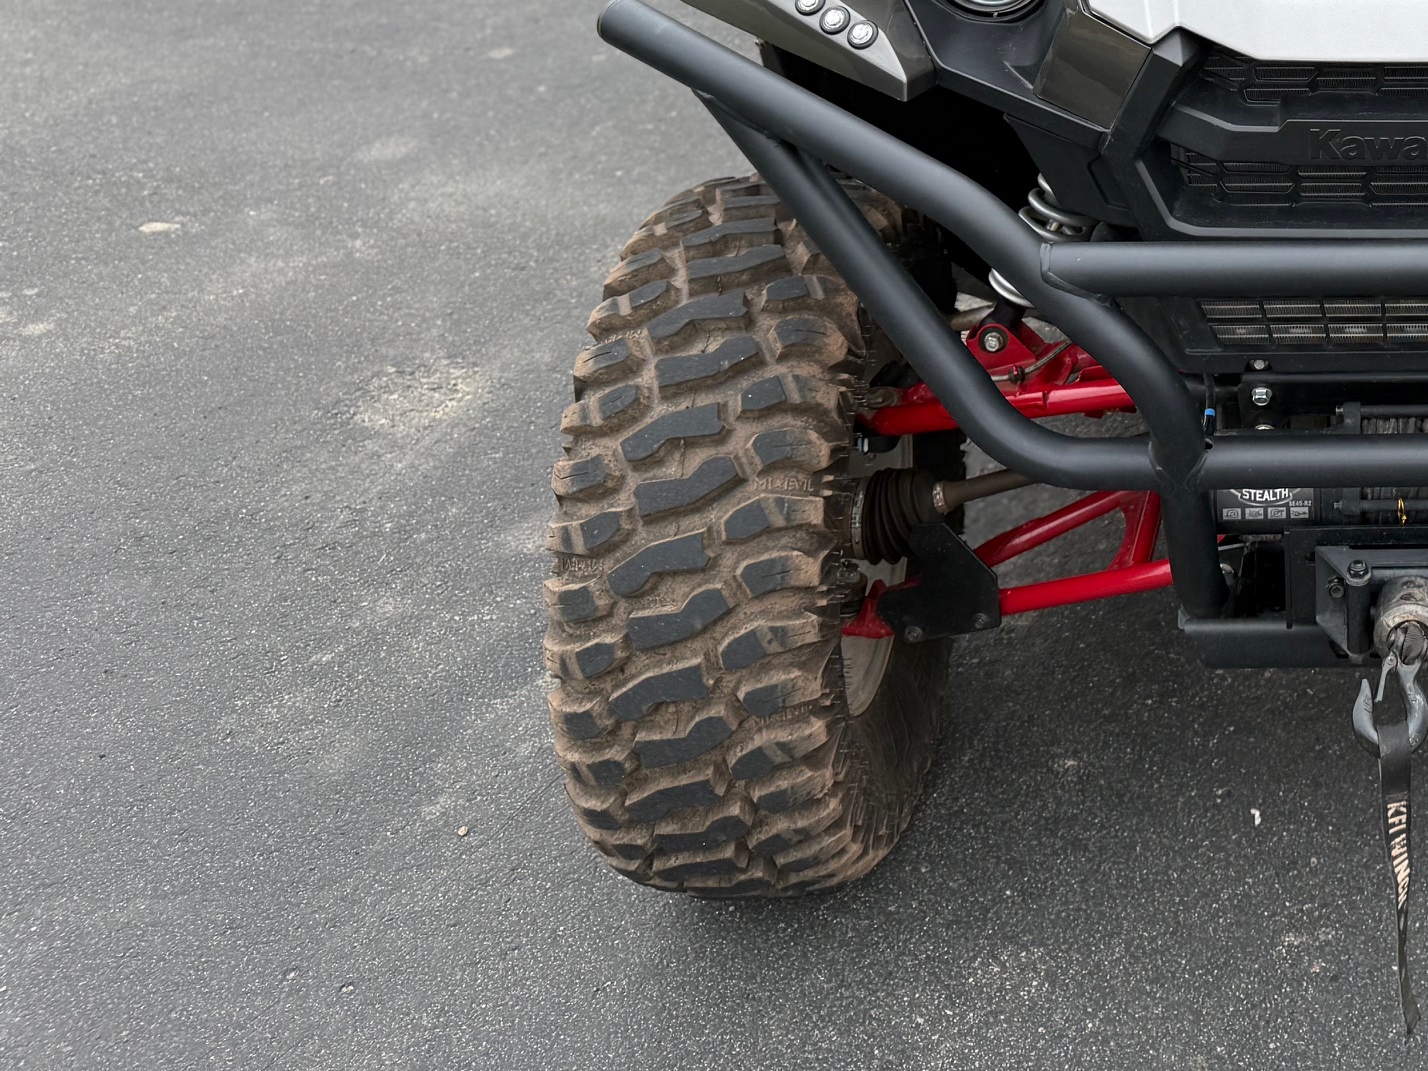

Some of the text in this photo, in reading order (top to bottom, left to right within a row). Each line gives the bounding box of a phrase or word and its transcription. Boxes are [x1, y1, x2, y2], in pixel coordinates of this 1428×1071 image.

[1242, 488, 1289, 502] STEALTH
[1386, 800, 1411, 910] KFI WINCH
